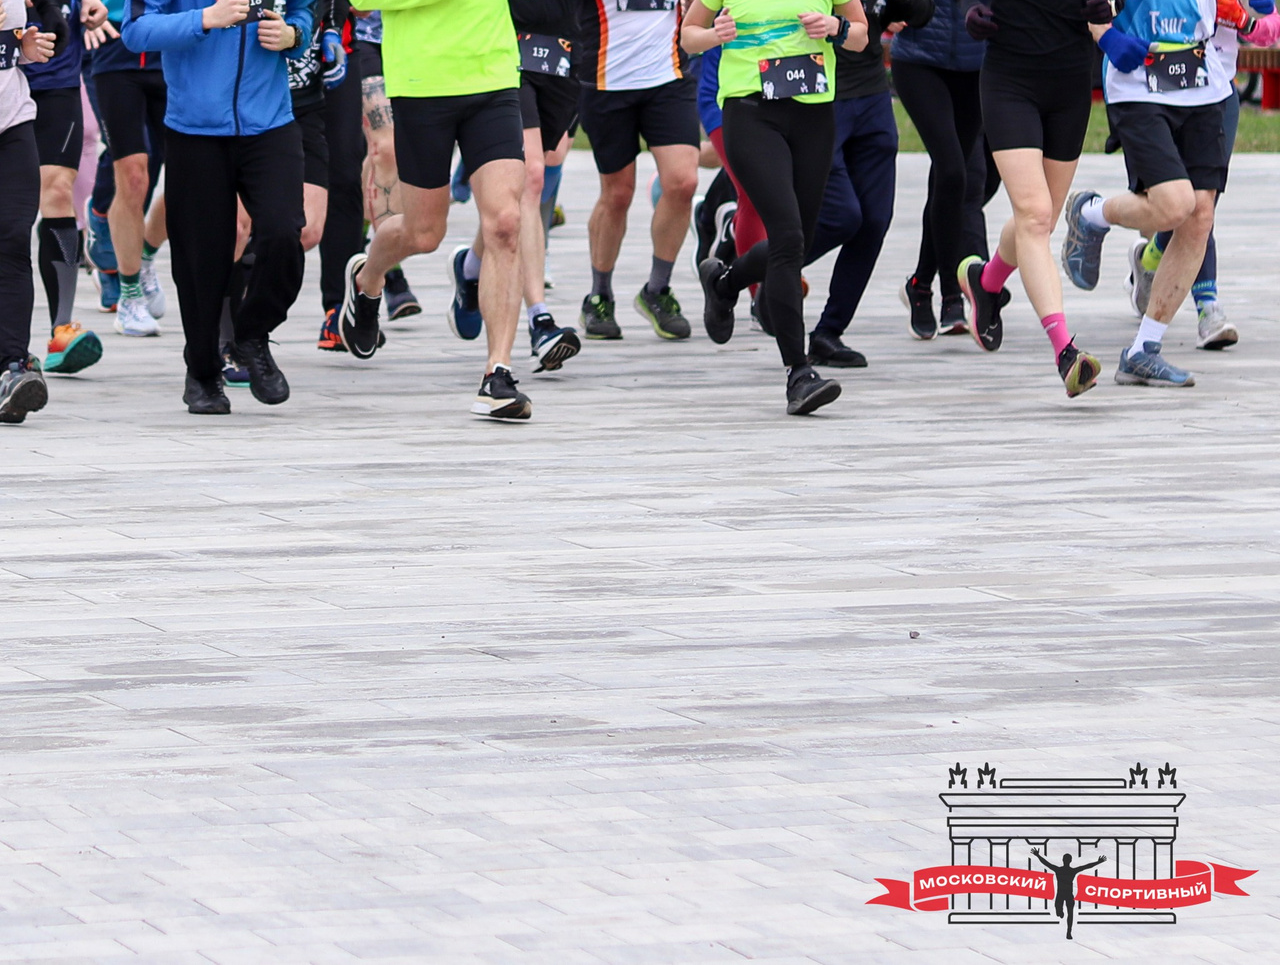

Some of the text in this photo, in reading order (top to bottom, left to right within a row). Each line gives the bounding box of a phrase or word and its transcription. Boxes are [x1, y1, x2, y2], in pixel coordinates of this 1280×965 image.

[532, 47, 550, 58] 137
[786, 69, 805, 81] 044
[1168, 63, 1186, 76] 053
